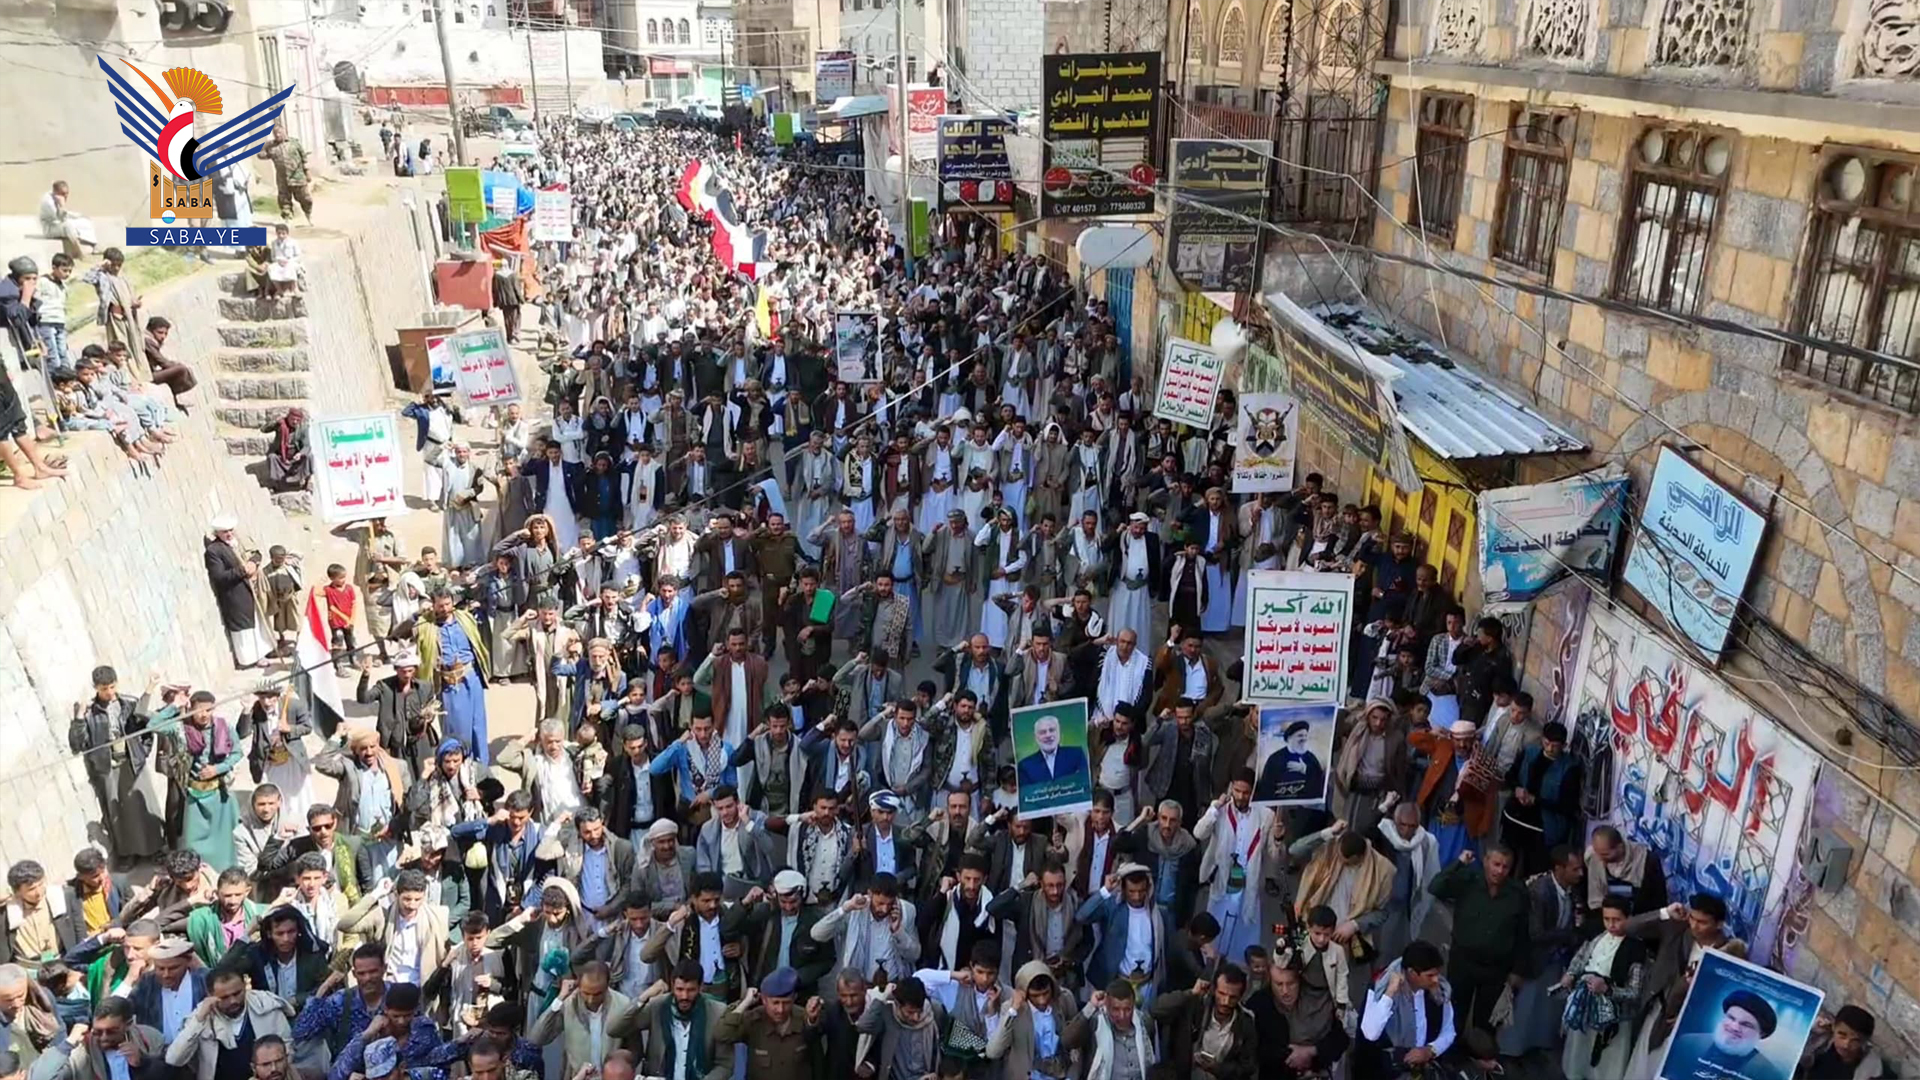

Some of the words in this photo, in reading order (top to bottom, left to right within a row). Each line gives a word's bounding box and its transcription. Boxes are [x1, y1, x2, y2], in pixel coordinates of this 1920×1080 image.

[1059, 60, 1146, 81] مجوهرات
[1050, 84, 1108, 110] الجرادي
[1112, 88, 1152, 102] محمد
[943, 121, 982, 137] الملك
[1049, 112, 1089, 130] الفضة
[1092, 115, 1100, 133] و
[1103, 110, 1149, 132] للذهب
[1062, 205, 1071, 213] 07
[1173, 352, 1202, 366] أكبر
[1201, 356, 1220, 370] الله
[325, 420, 384, 448] قاطعوا
[1667, 480, 1745, 544] الراقي
[1658, 510, 1694, 551] الحديثة
[1693, 539, 1730, 581] للخياطة
[1258, 593, 1309, 618] أكبر
[1310, 597, 1342, 614] الله
[1257, 618, 1300, 635] لأمريكا
[1303, 622, 1339, 636] الموت
[1302, 641, 1338, 655] الموت
[1254, 659, 1284, 673] اليهود
[1287, 660, 1304, 673] على
[1309, 659, 1336, 672] اللعنة
[1252, 675, 1294, 695] للإسلام
[1297, 676, 1335, 695] النصر
[1609, 662, 1775, 837] الراقي
